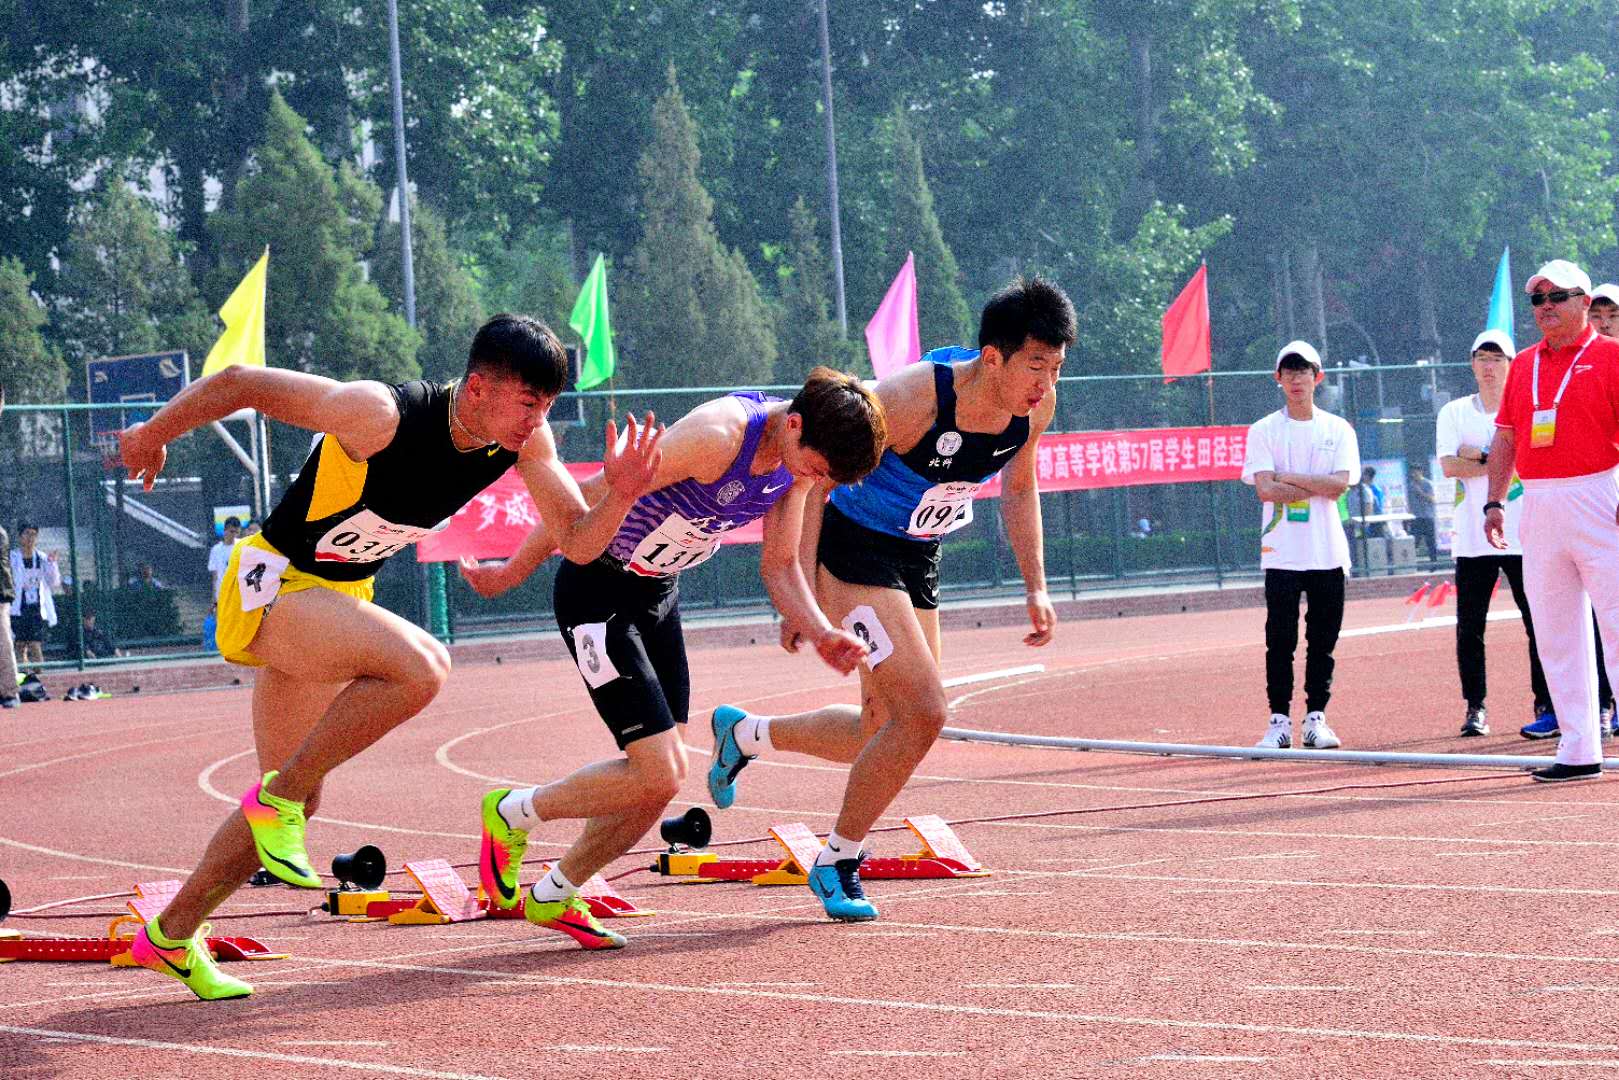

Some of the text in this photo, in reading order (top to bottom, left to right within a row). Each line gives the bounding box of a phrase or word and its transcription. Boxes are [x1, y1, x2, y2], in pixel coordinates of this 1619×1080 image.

[1038, 434, 1247, 480] 都高等学校第57届学生田径运
[456, 492, 537, 531] 多威
[244, 562, 267, 592] 4
[582, 633, 601, 674] 3
[853, 621, 879, 654] 2
